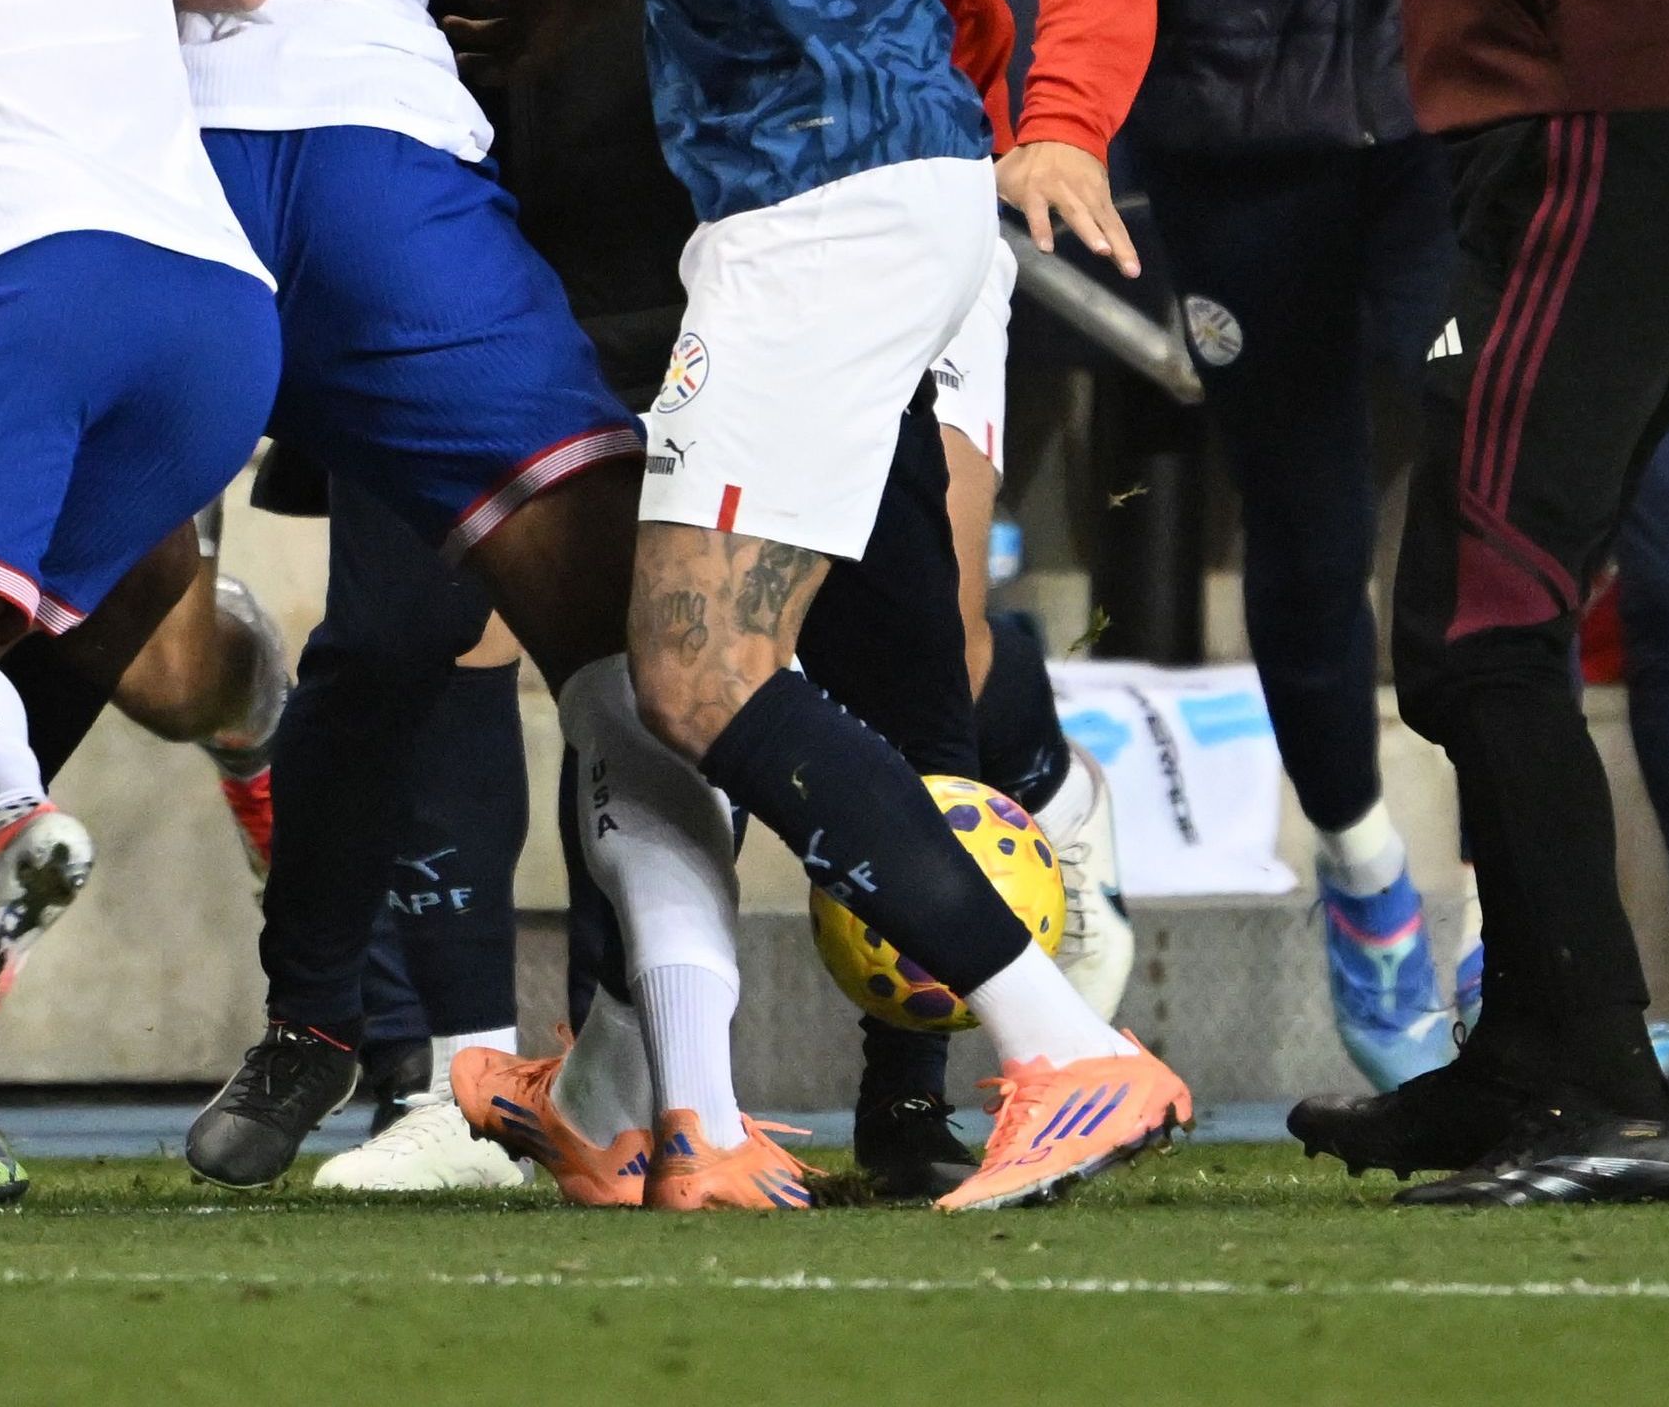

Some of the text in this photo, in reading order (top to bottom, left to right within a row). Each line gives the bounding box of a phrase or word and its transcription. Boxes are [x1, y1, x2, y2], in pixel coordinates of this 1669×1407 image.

[647, 456, 676, 475] UMA
[592, 758, 620, 840] USA
[832, 860, 879, 904] PF
[388, 887, 472, 914] APF
